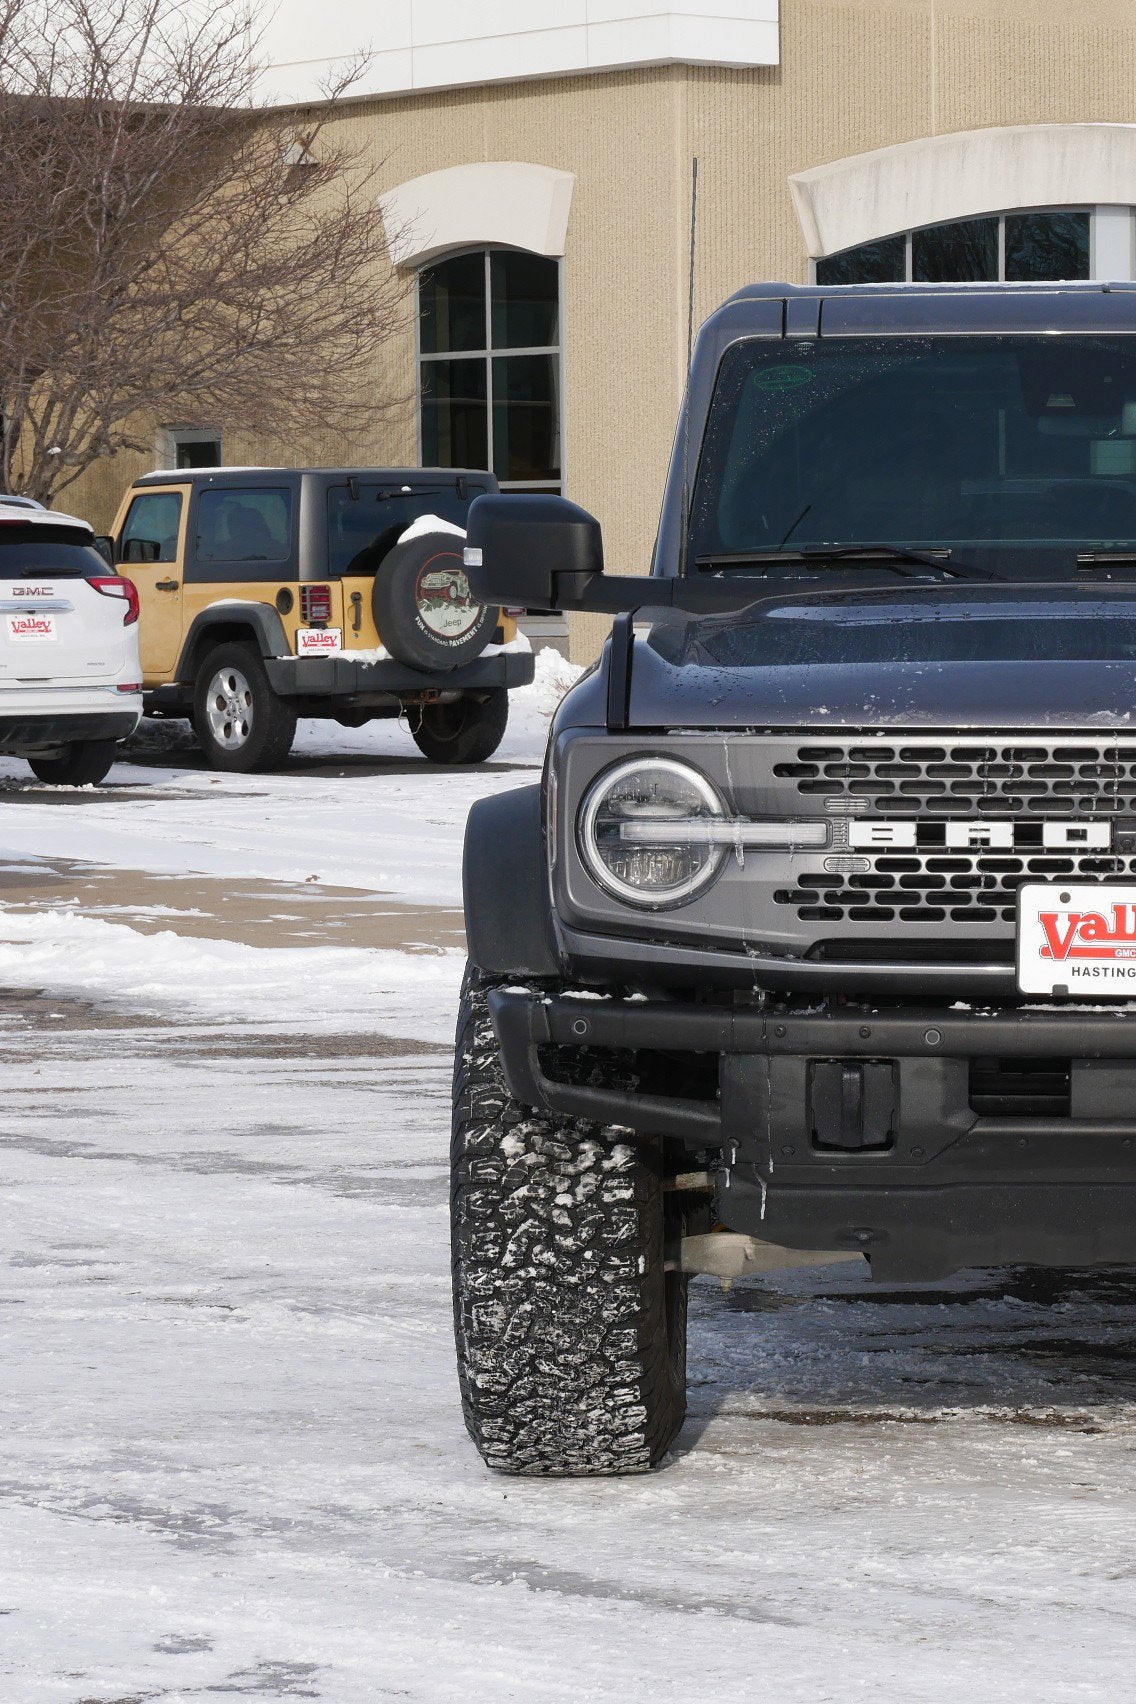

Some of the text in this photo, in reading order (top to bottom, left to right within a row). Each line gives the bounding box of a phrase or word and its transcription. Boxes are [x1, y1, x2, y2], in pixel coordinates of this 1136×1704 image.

[12, 586, 55, 596] GMC
[11, 618, 52, 634] Valley
[443, 618, 462, 628] Jeep
[415, 615, 426, 631] FUN
[448, 626, 479, 648] PAVEMENT
[302, 633, 338, 648] Valley
[1114, 949, 1136, 958] GMC
